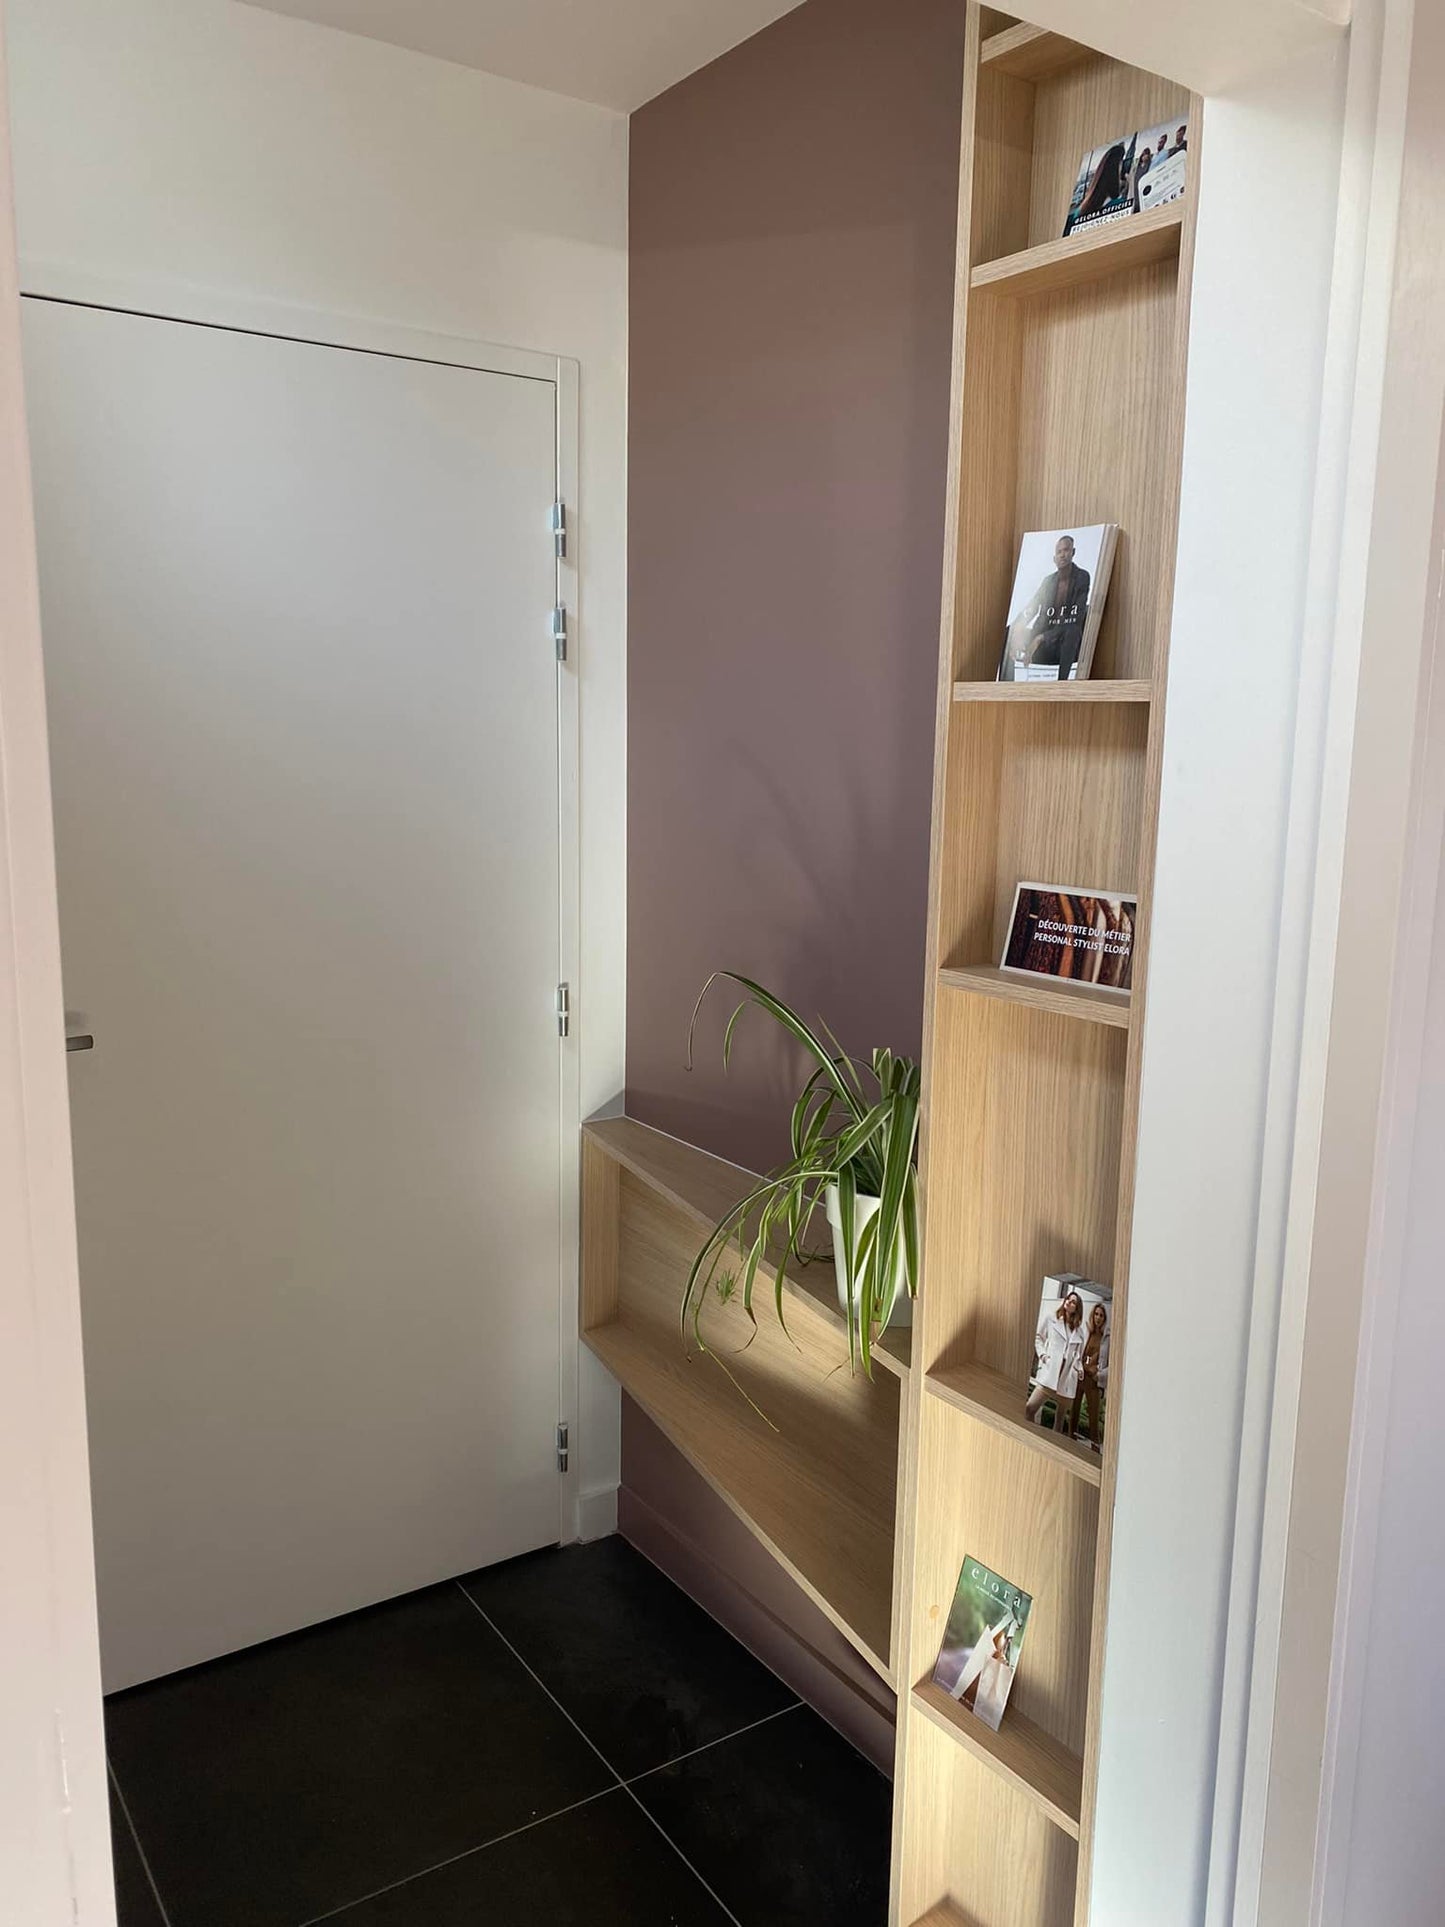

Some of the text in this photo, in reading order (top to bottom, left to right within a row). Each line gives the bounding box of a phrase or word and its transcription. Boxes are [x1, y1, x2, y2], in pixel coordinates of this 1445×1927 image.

[1038, 919, 1131, 942] DÉCOUVERTE DU MÉTIER
[1034, 932, 1130, 956] PERSONAL STYLIST ELORA
[971, 1567, 1021, 1608] elora
